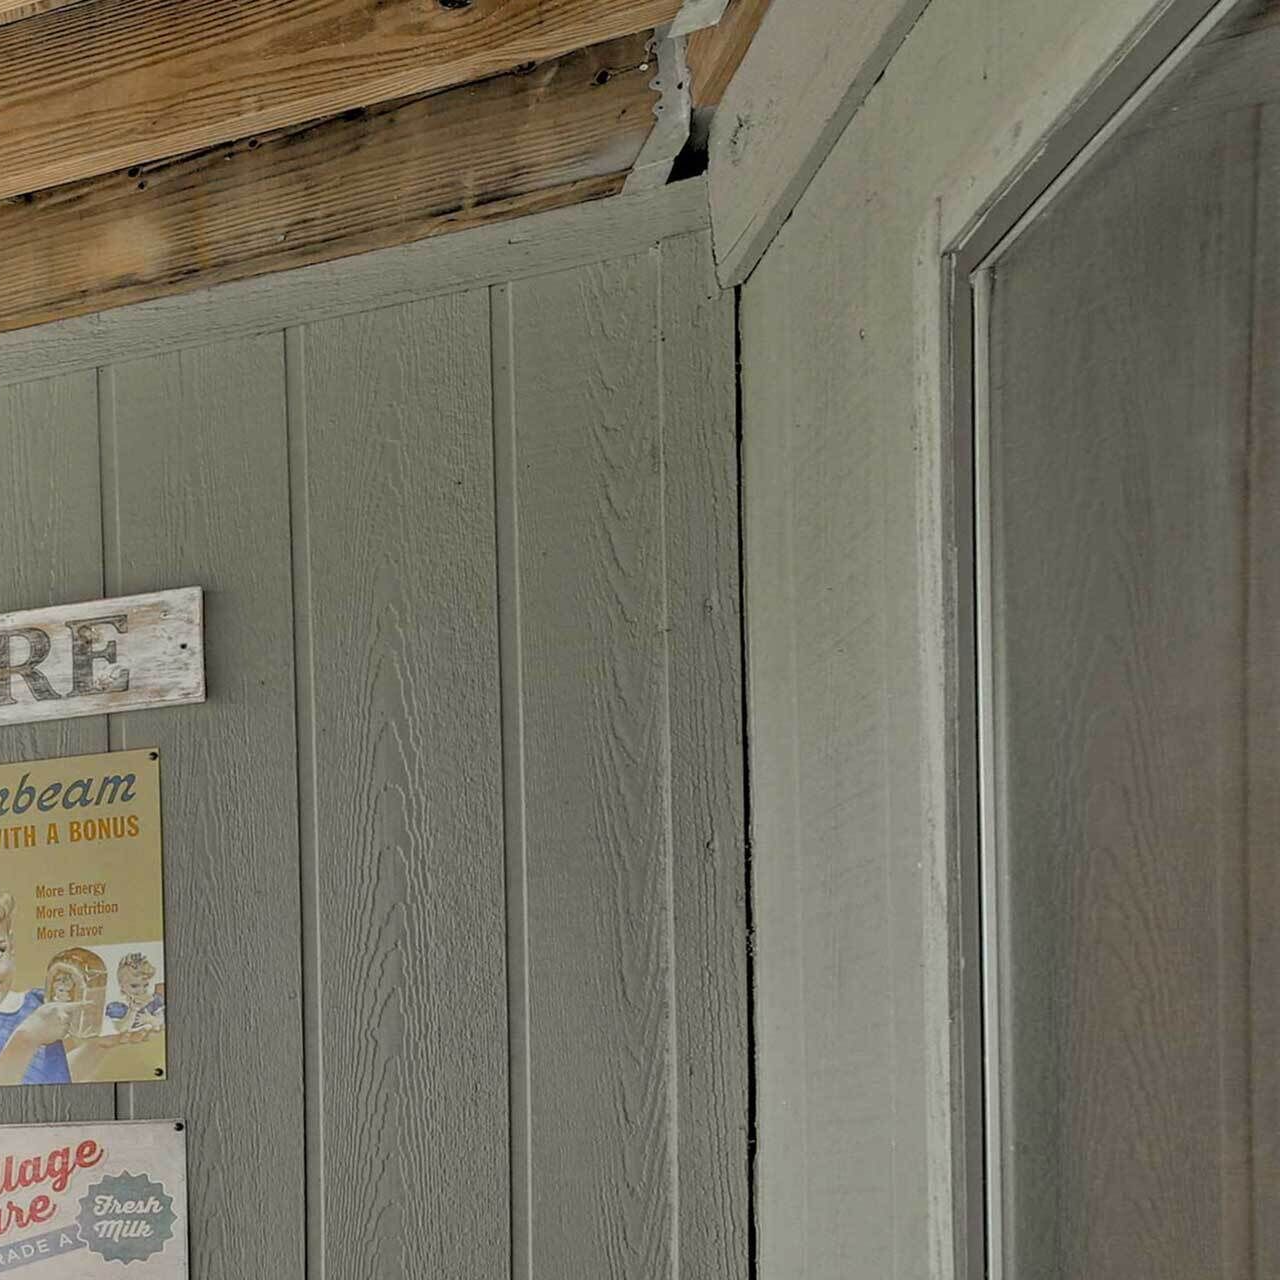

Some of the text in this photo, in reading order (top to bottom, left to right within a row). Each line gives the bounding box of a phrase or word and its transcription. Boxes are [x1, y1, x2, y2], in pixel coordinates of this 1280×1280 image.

[46, 821, 60, 846] A
[69, 815, 140, 843] BONUS
[36, 881, 106, 899] More Energy
[36, 902, 118, 920] More Nutrition
[37, 924, 104, 941] More Flavor
[93, 1194, 164, 1216] Fresh
[59, 1233, 74, 1247] A
[93, 1220, 154, 1243] Milk
